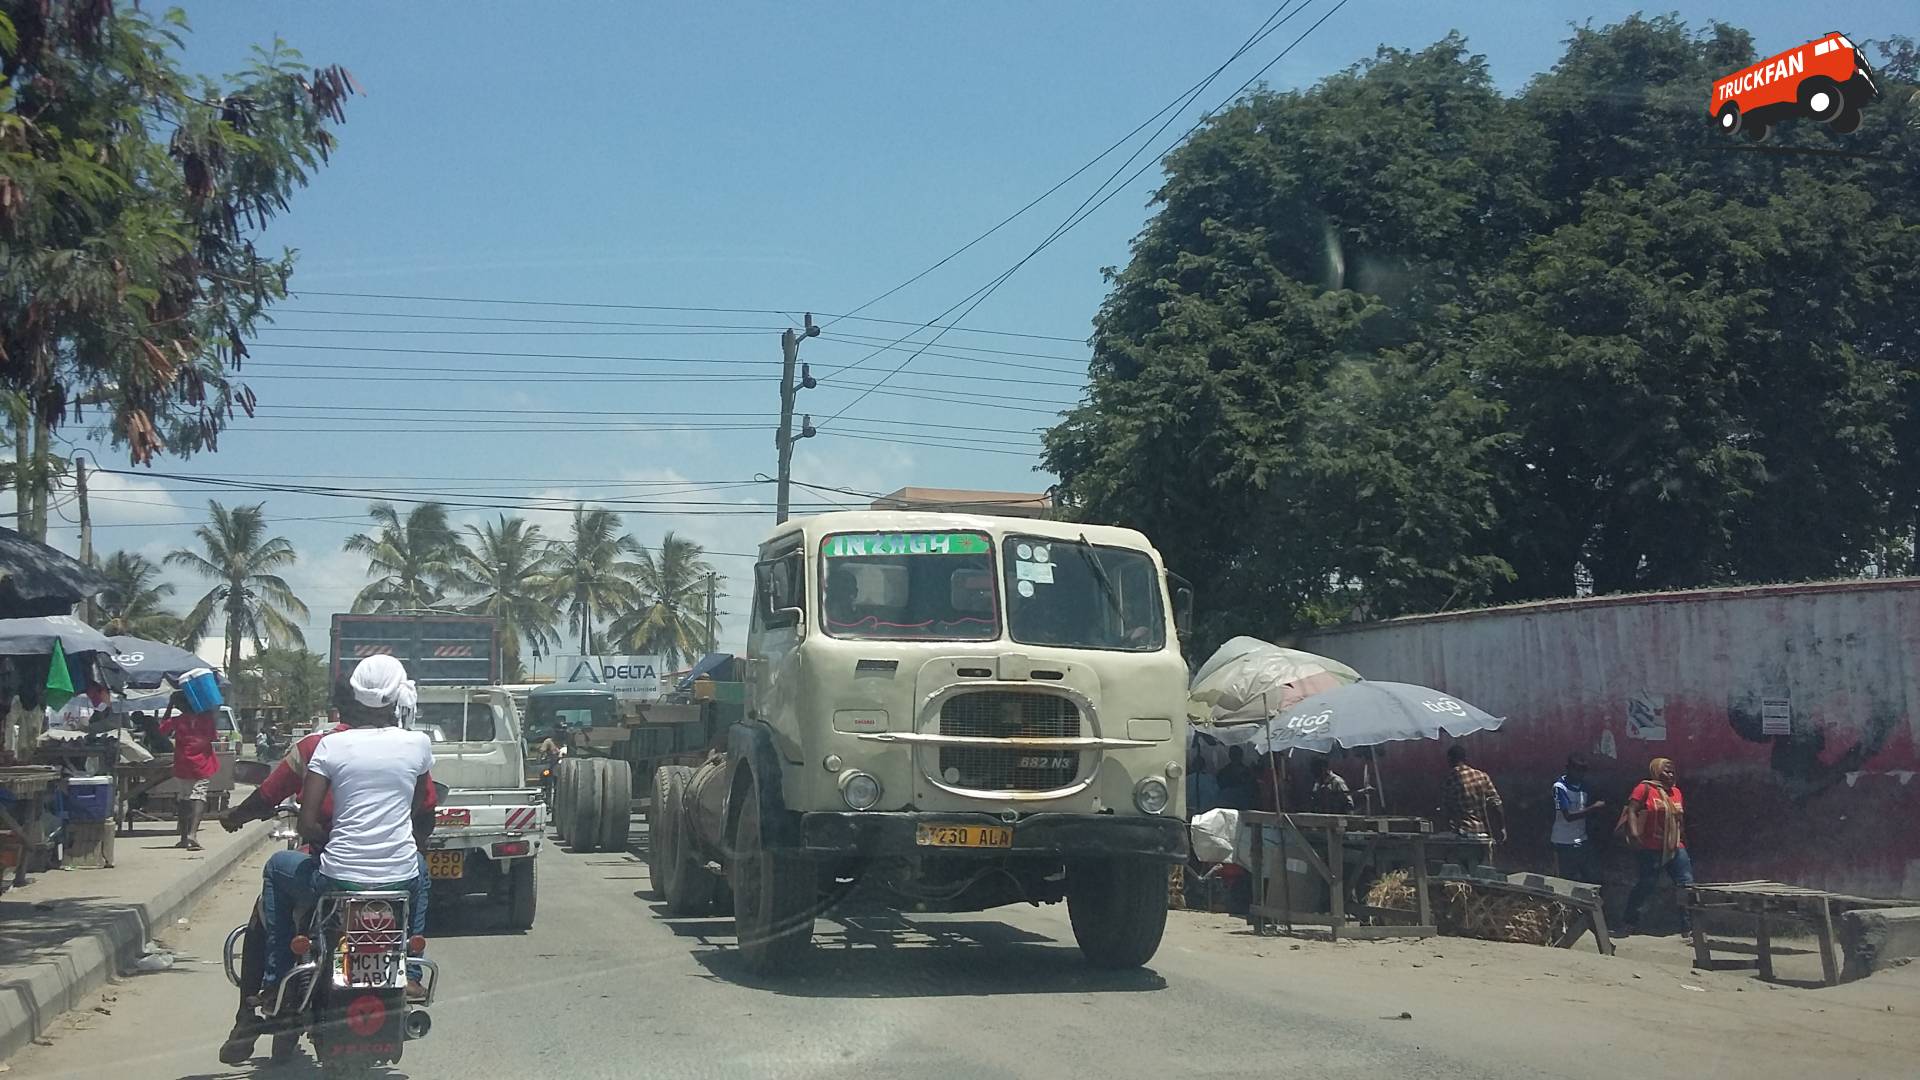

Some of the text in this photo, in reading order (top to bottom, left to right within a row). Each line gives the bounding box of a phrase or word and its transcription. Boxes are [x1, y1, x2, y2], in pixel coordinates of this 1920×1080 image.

[604, 665, 656, 679] DELTA
[1420, 697, 1467, 717] tigo
[1287, 709, 1334, 734] tigo
[1020, 757, 1071, 769] 682 N3
[979, 829, 1009, 846] ALA
[431, 853, 461, 864] 650
[430, 865, 461, 877] CCC
